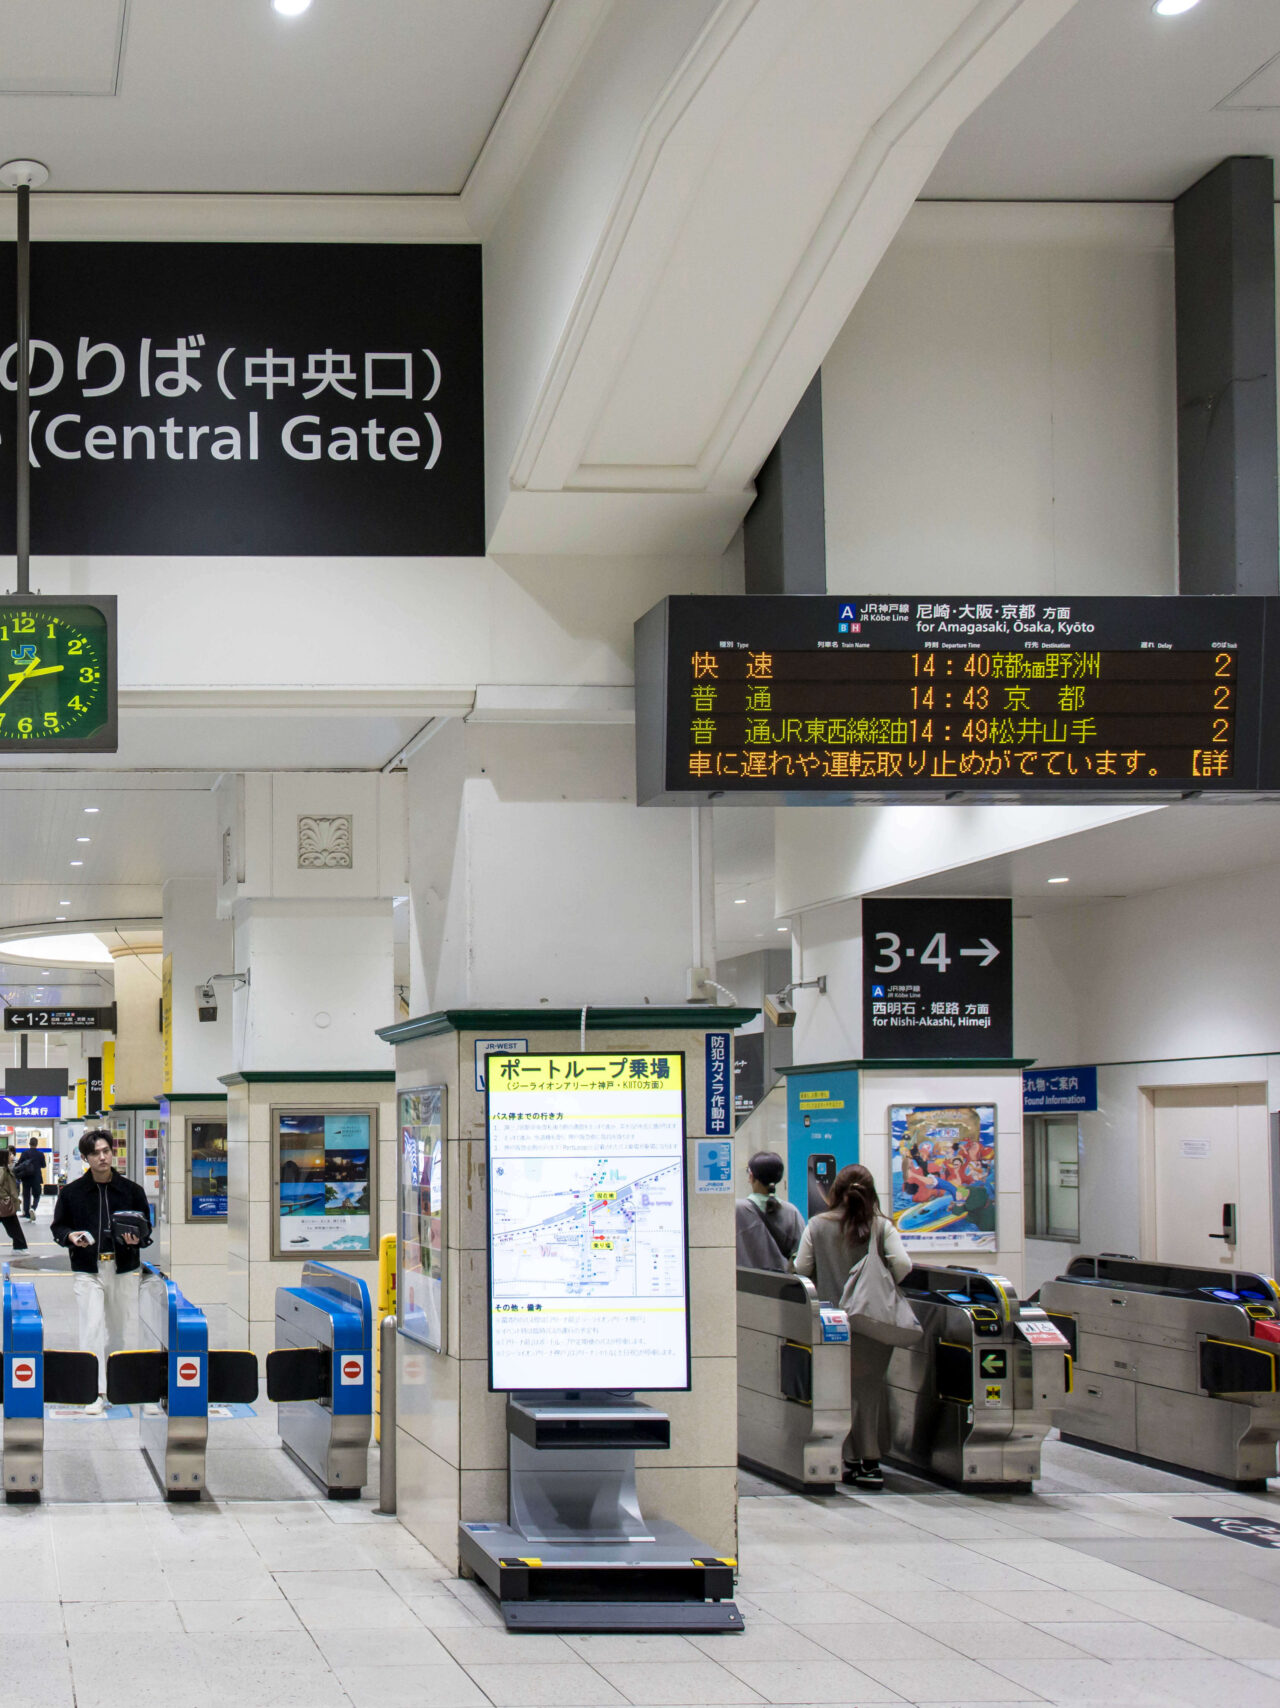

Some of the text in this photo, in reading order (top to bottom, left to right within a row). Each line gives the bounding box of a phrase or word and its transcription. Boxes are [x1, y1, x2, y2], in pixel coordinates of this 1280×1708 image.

[29, 411, 260, 469] (Central
[281, 411, 443, 469] Gate)
[841, 606, 854, 619] A
[860, 603, 909, 614] JR神戸線
[1042, 607, 1071, 619] 方面
[12, 618, 35, 633] 12
[47, 624, 56, 638] 1
[916, 621, 934, 632] for
[938, 621, 1010, 635] Amagasaki,
[11, 645, 36, 659] JR
[68, 640, 82, 655] 2
[941, 642, 967, 650] Departure
[1157, 642, 1172, 650] Delay
[912, 653, 990, 677] 14:40
[1215, 653, 1232, 677] 2
[80, 667, 94, 683] 3
[68, 695, 83, 710] 4
[910, 686, 989, 710] 14:43
[1214, 686, 1230, 709] 2
[17, 717, 33, 733] 6
[44, 712, 58, 727] 5
[909, 719, 988, 743] 14:49
[989, 717, 1097, 744] 松井山手
[1213, 719, 1229, 742] 2
[689, 750, 1157, 778] 車に遅れや運転取り止めがでています。
[965, 1003, 990, 1015] 方面
[872, 1016, 991, 1028] for Nishi-Akashi, Himeji
[500, 1057, 671, 1081] ポートループ乗場
[710, 1035, 726, 1132] 防犯カメラ作動中
[1024, 1094, 1086, 1105] Found Information
[14, 1107, 48, 1116] 日本旅行
[492, 1112, 564, 1121] バス停までの行き方
[720, 1144, 730, 1180] PiTaPa
